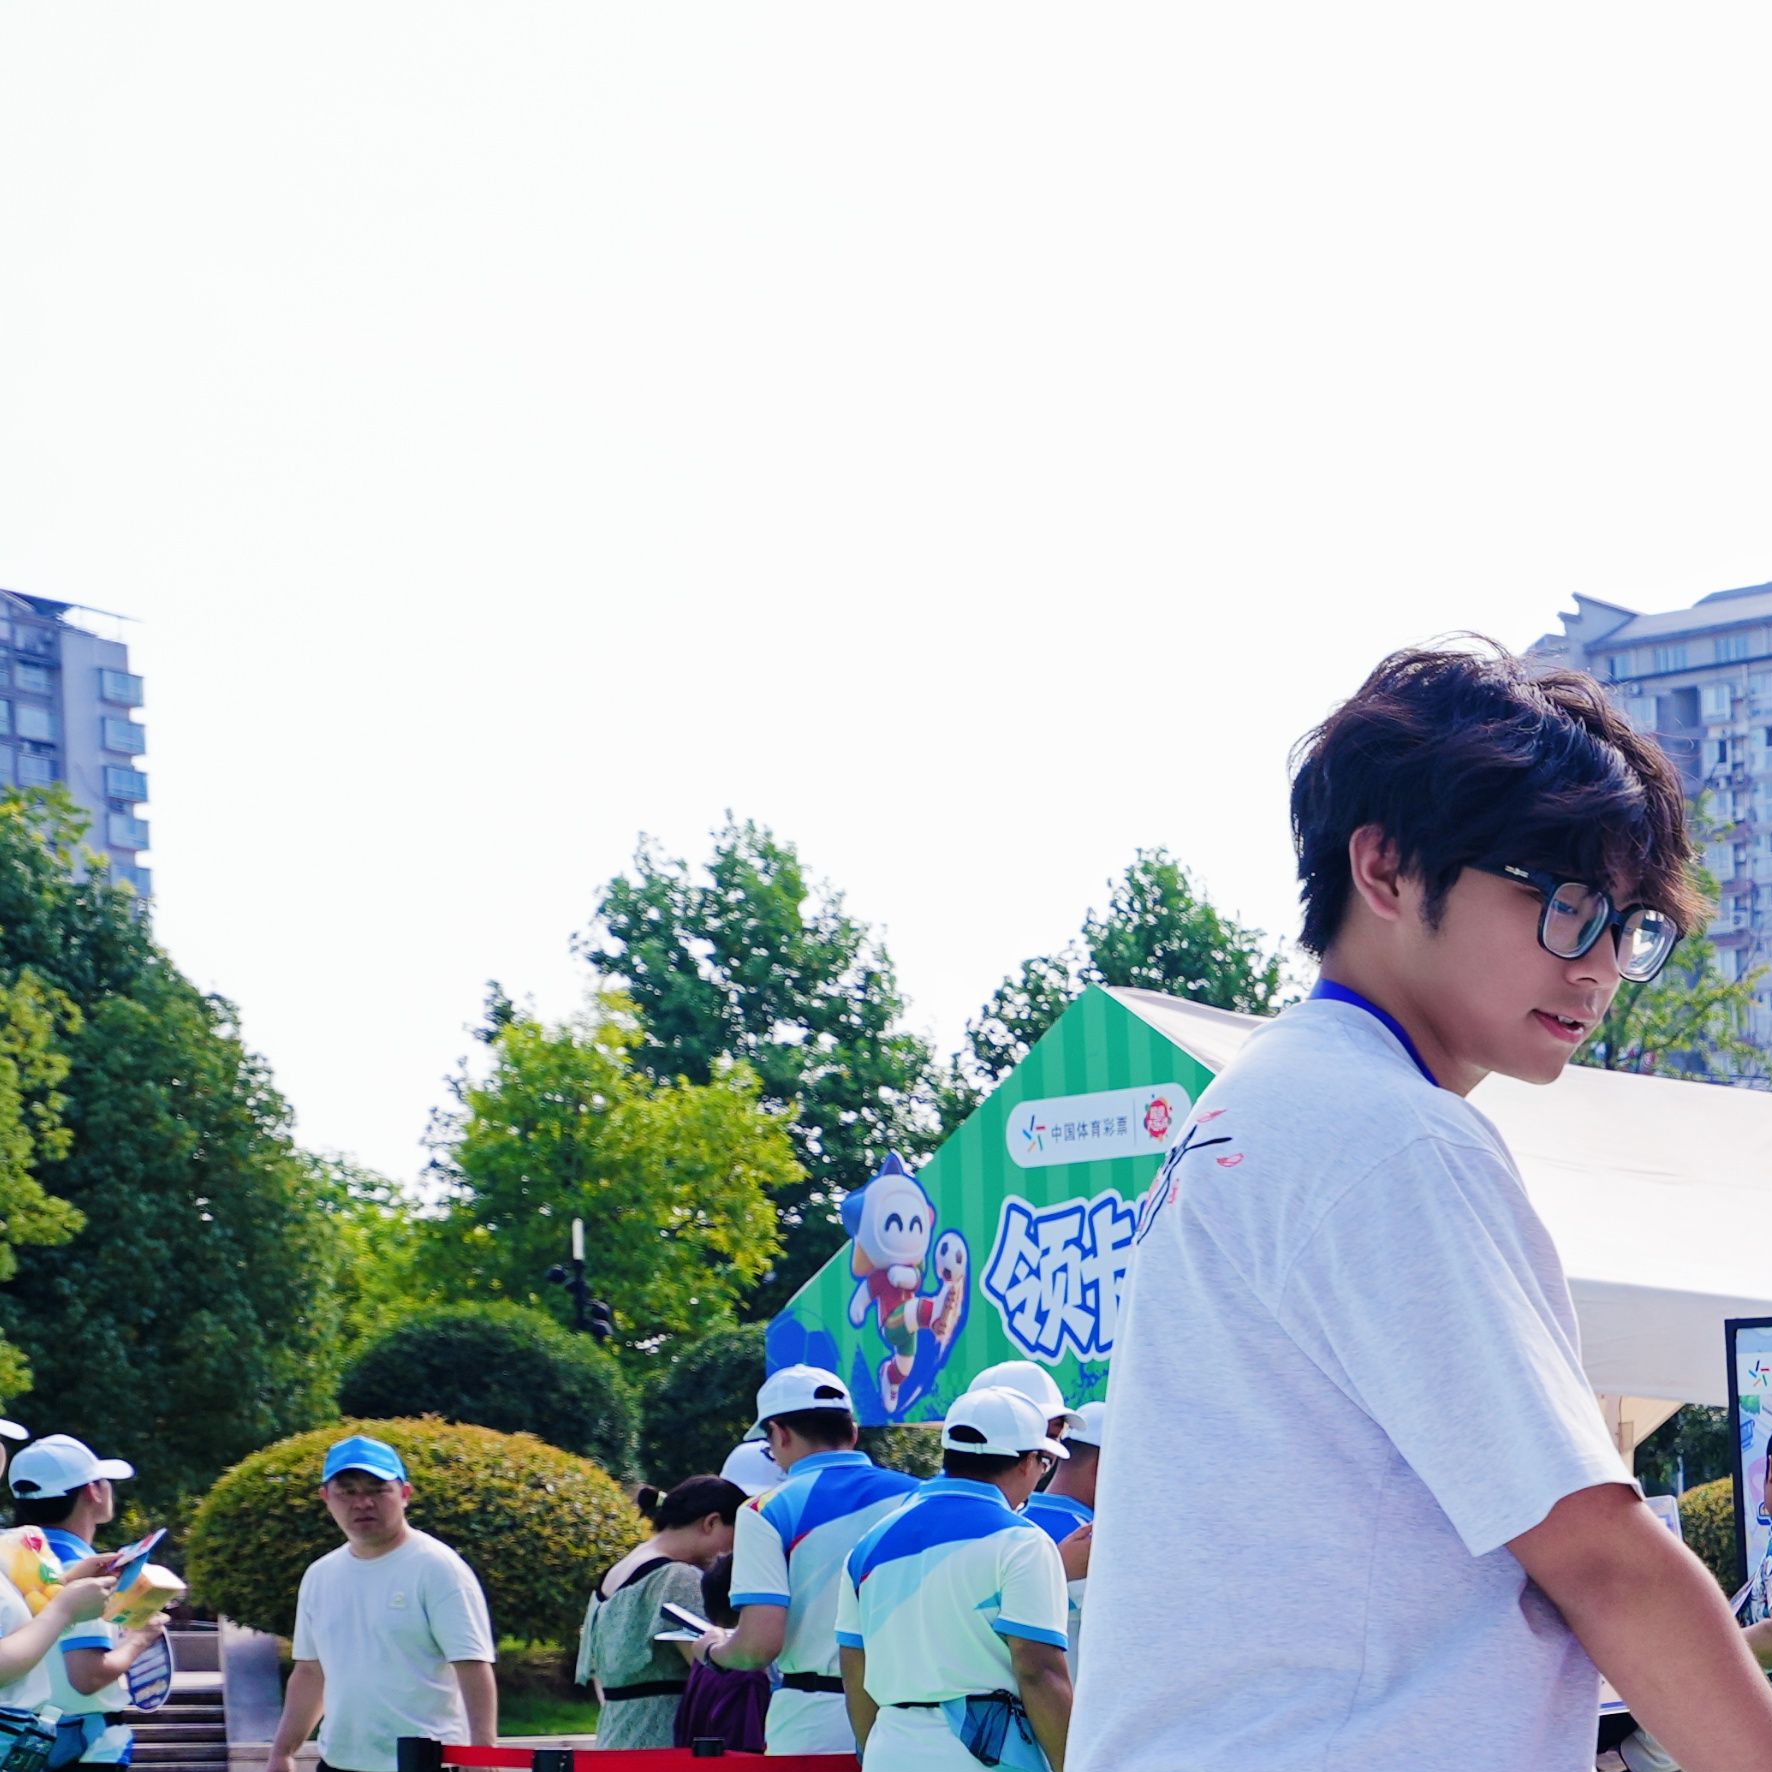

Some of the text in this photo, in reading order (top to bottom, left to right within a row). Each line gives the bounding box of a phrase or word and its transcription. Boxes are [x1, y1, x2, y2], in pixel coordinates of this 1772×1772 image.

[1051, 1116, 1127, 1143] 中国体育彩票
